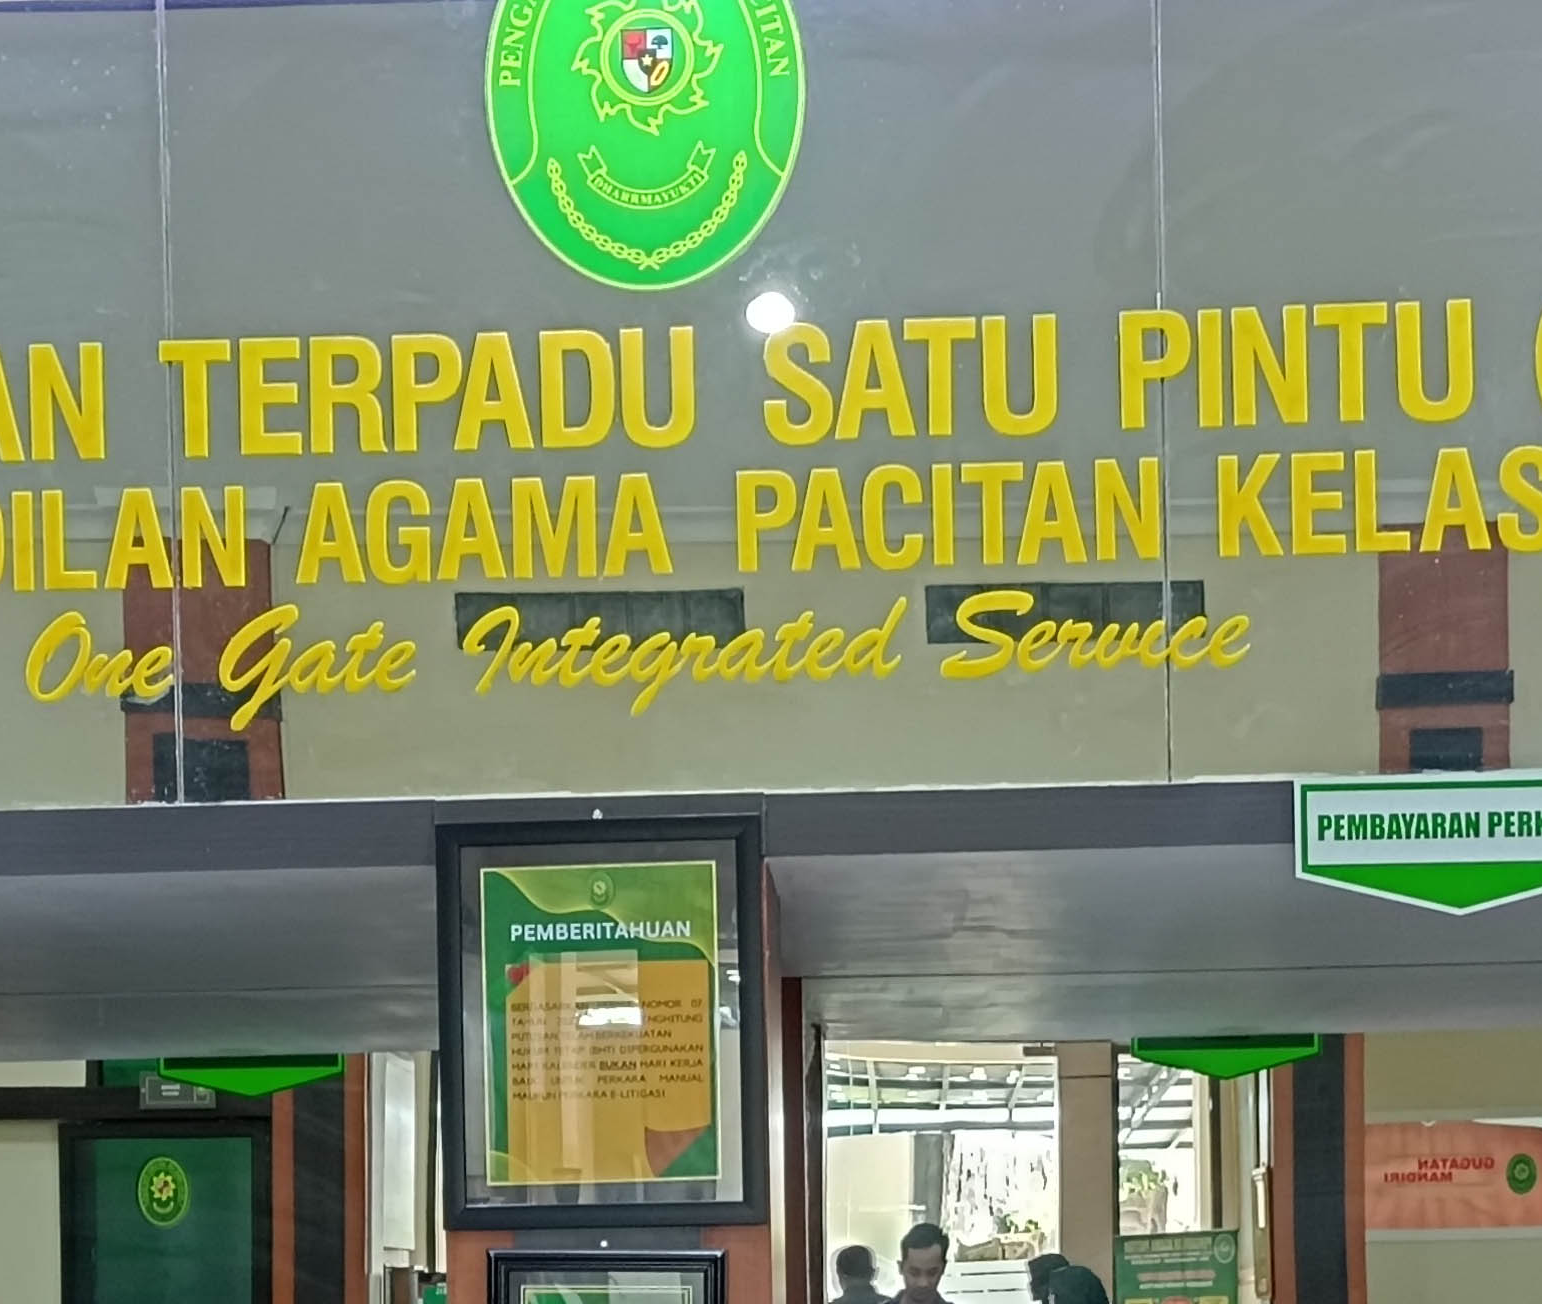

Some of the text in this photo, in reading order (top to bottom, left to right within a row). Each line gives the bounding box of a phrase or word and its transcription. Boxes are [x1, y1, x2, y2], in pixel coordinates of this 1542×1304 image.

[498, 0, 537, 87] PENG
[750, 0, 790, 77] ITAN
[158, 326, 696, 459] TERPADU
[763, 313, 1058, 446] SATU
[1119, 298, 1474, 429] PINTU
[295, 470, 673, 584] AGAMA
[735, 455, 1163, 573] PACITAN
[25, 588, 1252, 730] One Gate Integrated Service
[1317, 811, 1481, 840] PEMBAYARAN
[510, 920, 692, 942] PEMBERITAHUAN
[643, 1000, 682, 1009] NOMOR
[599, 1060, 637, 1071] BUKAN
[640, 1060, 667, 1068] HARI
[670, 1059, 704, 1068] KERJA
[659, 1074, 704, 1083] MANUAL
